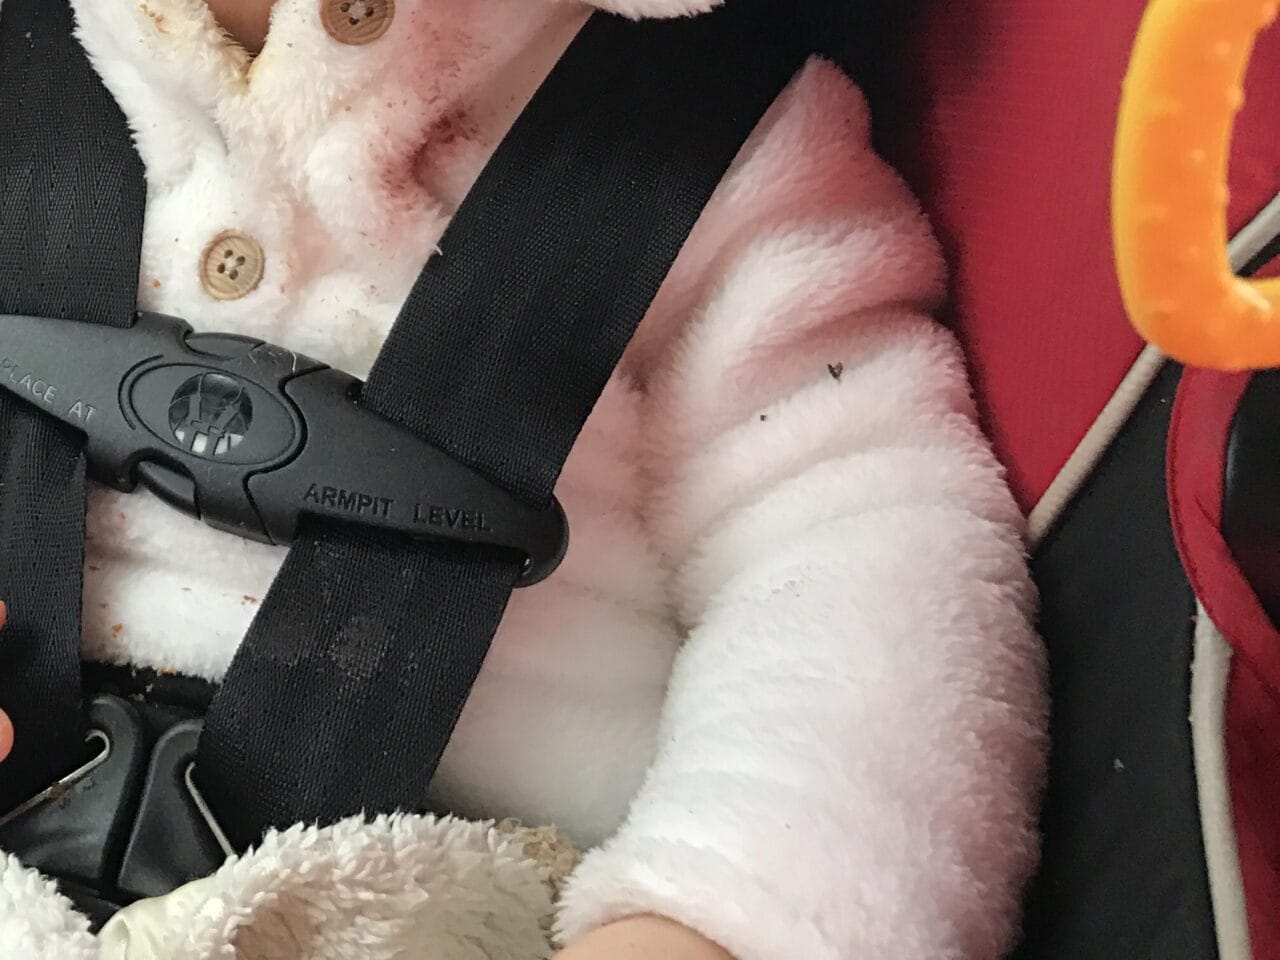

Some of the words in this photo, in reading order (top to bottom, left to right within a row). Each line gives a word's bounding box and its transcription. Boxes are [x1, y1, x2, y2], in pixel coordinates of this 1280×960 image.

[67, 399, 97, 423] AT
[302, 482, 395, 520] ARMPIT
[412, 503, 494, 534] LEVEL
